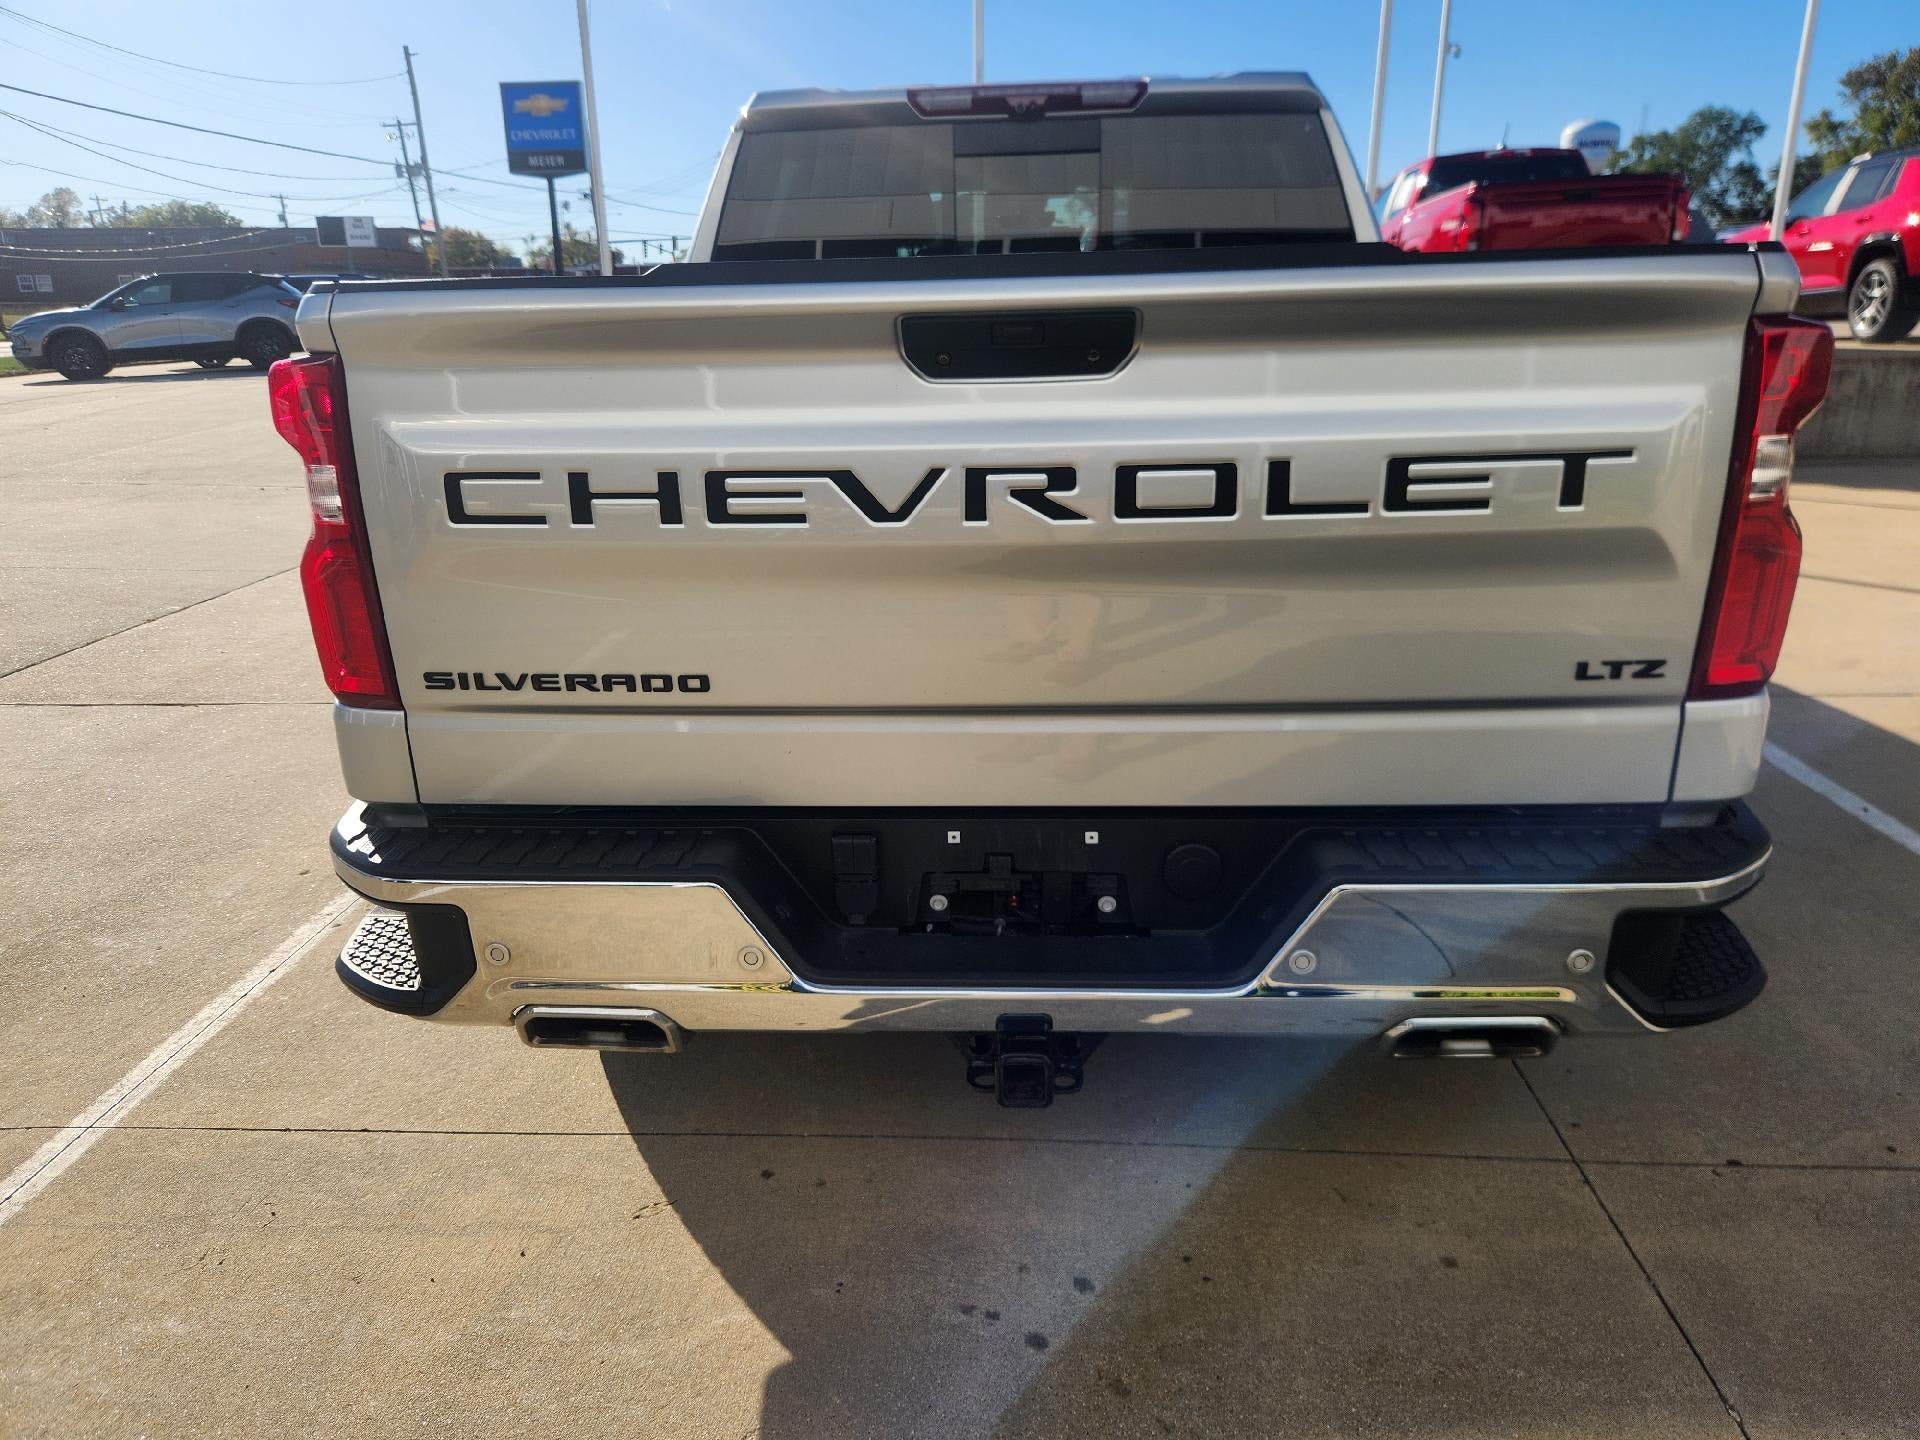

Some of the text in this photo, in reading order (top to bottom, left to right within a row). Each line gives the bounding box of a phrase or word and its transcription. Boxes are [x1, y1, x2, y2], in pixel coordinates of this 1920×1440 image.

[510, 128, 576, 141] CHEVROLET
[443, 447, 1637, 528] CHEVROLET
[1574, 659, 1667, 681] LTZ
[423, 670, 712, 694] SILVERADO
